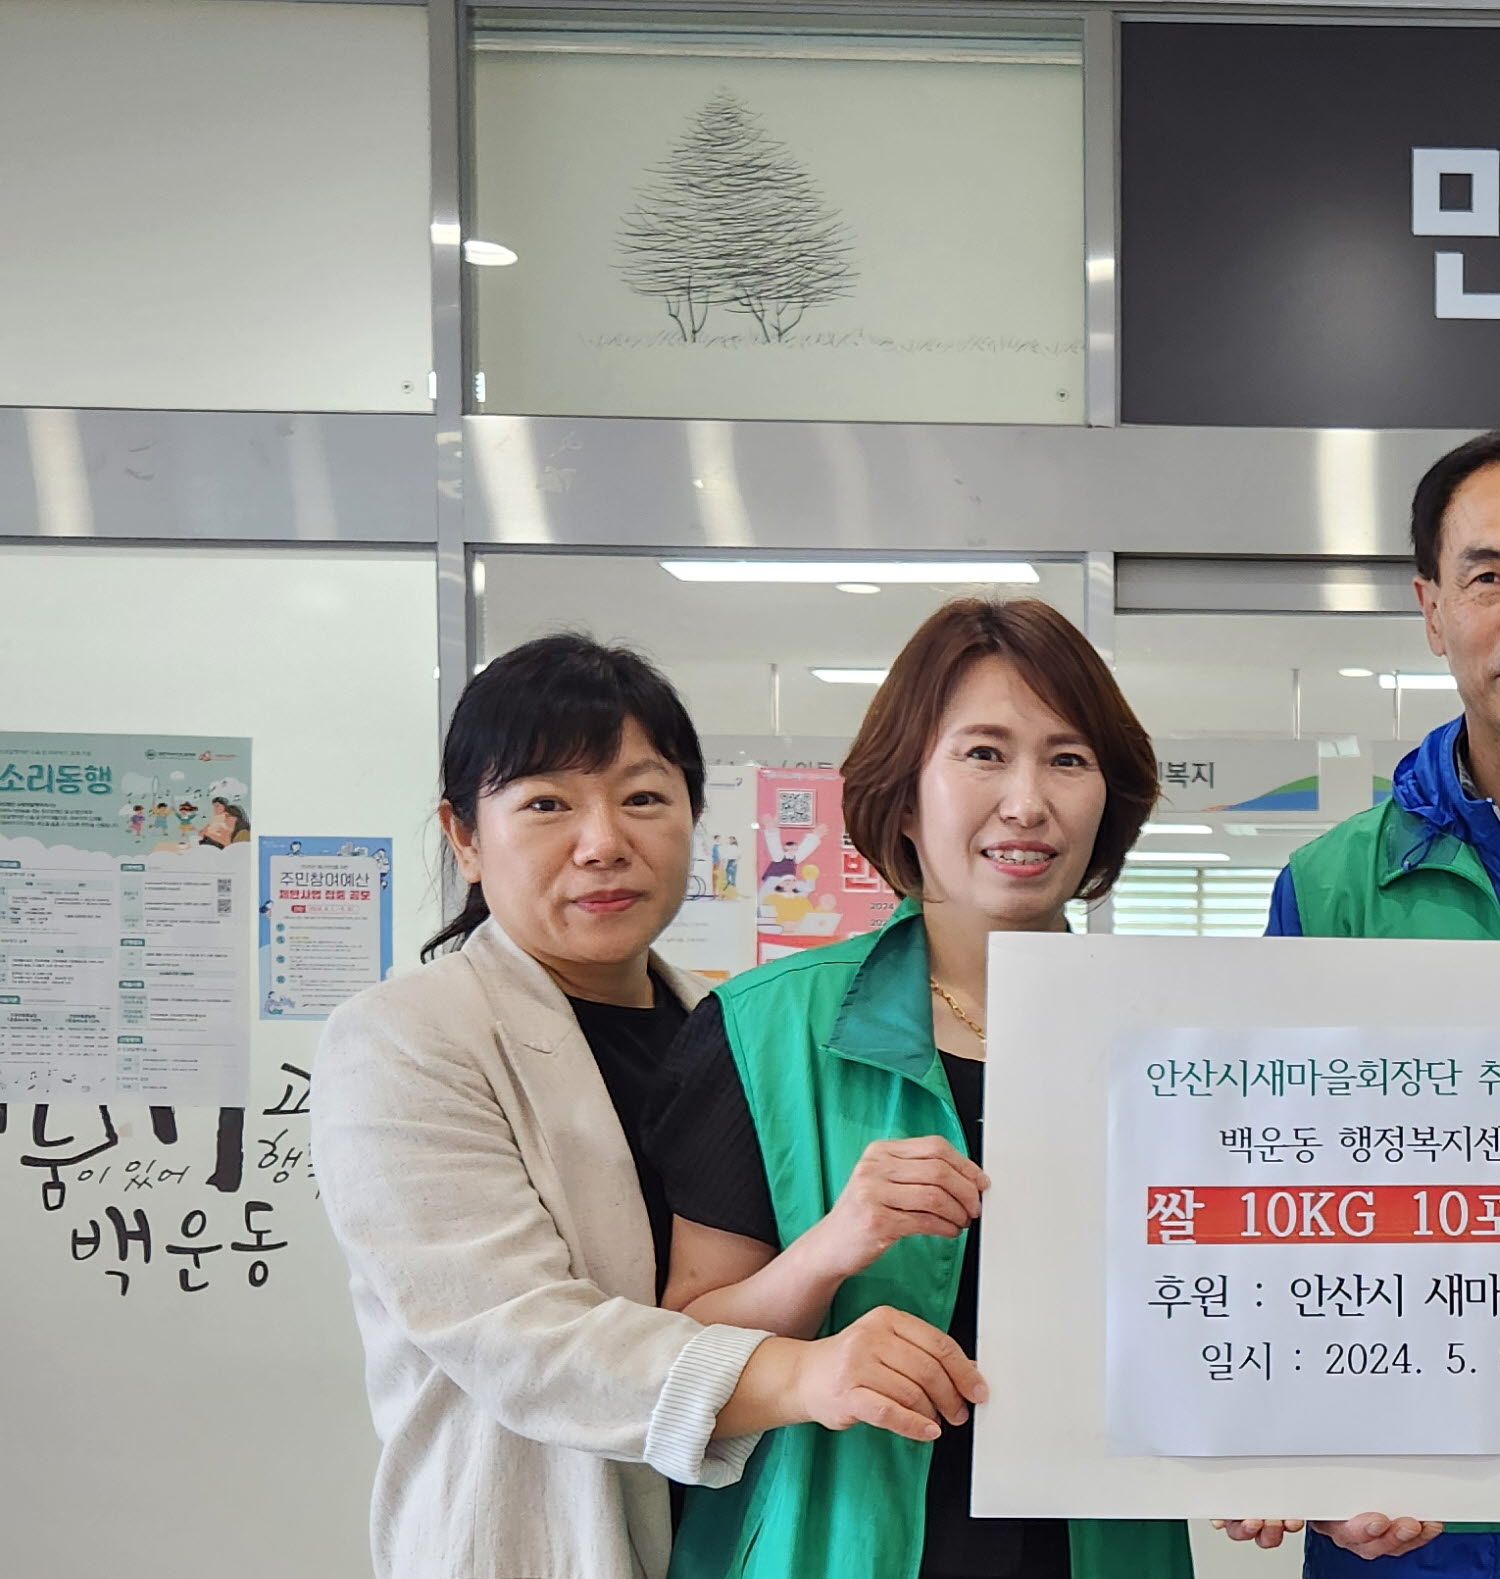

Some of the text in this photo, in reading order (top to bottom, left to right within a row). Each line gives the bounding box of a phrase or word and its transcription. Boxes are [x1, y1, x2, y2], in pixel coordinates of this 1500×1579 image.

[280, 871, 370, 888] 주민참여예산
[1146, 1057, 1462, 1098] 안산시새마을회장단
[1218, 1127, 1323, 1165] 백운동
[124, 1158, 191, 1193] 있어
[1147, 1189, 1205, 1244] 쌀
[1240, 1190, 1376, 1239] 10KG
[70, 1200, 289, 1298] 백운동
[1147, 1273, 1230, 1320] 후원
[1289, 1271, 1405, 1319] 안산시
[1201, 1341, 1272, 1382] 일시
[1325, 1343, 1423, 1377] 2024.
[1446, 1343, 1477, 1377] 5.
